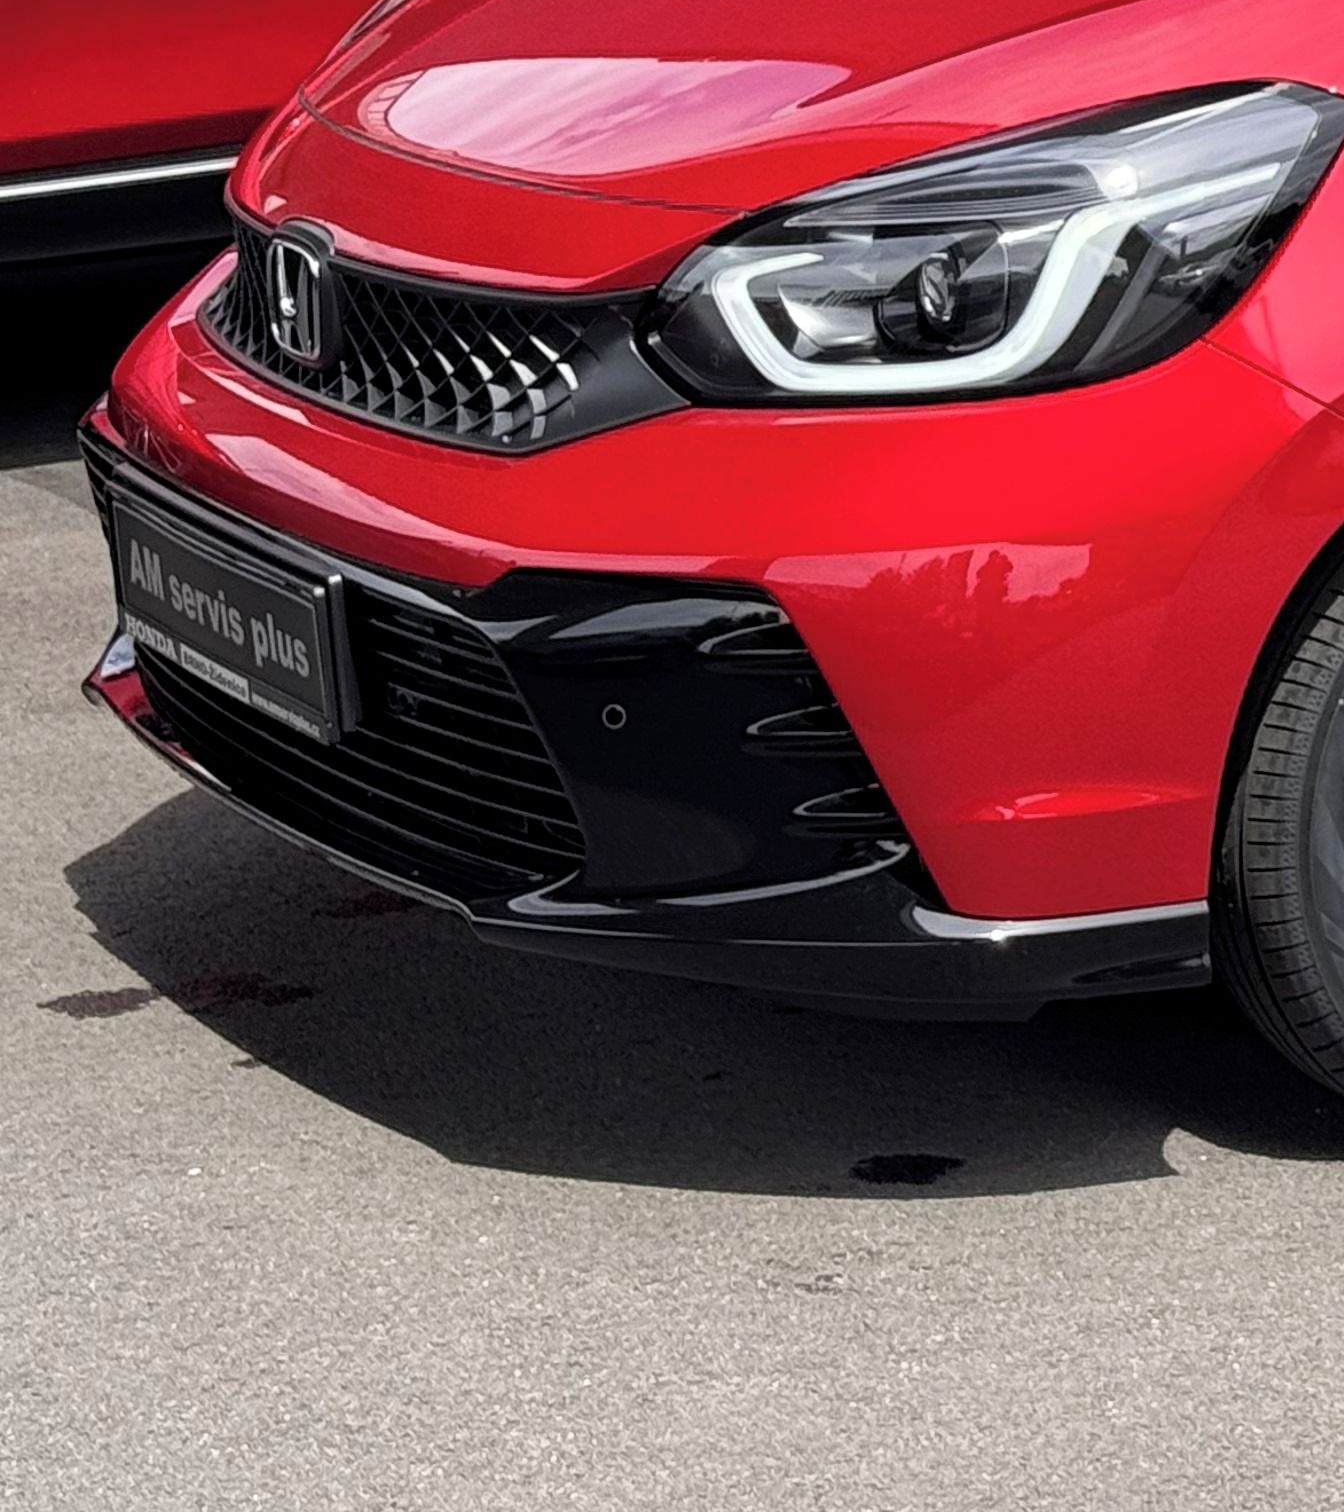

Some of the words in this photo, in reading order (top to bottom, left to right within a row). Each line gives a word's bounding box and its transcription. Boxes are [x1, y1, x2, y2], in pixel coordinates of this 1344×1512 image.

[124, 611, 178, 662] HONDA
[131, 538, 165, 601] AM
[168, 573, 245, 646] servis
[251, 611, 310, 678] plus
